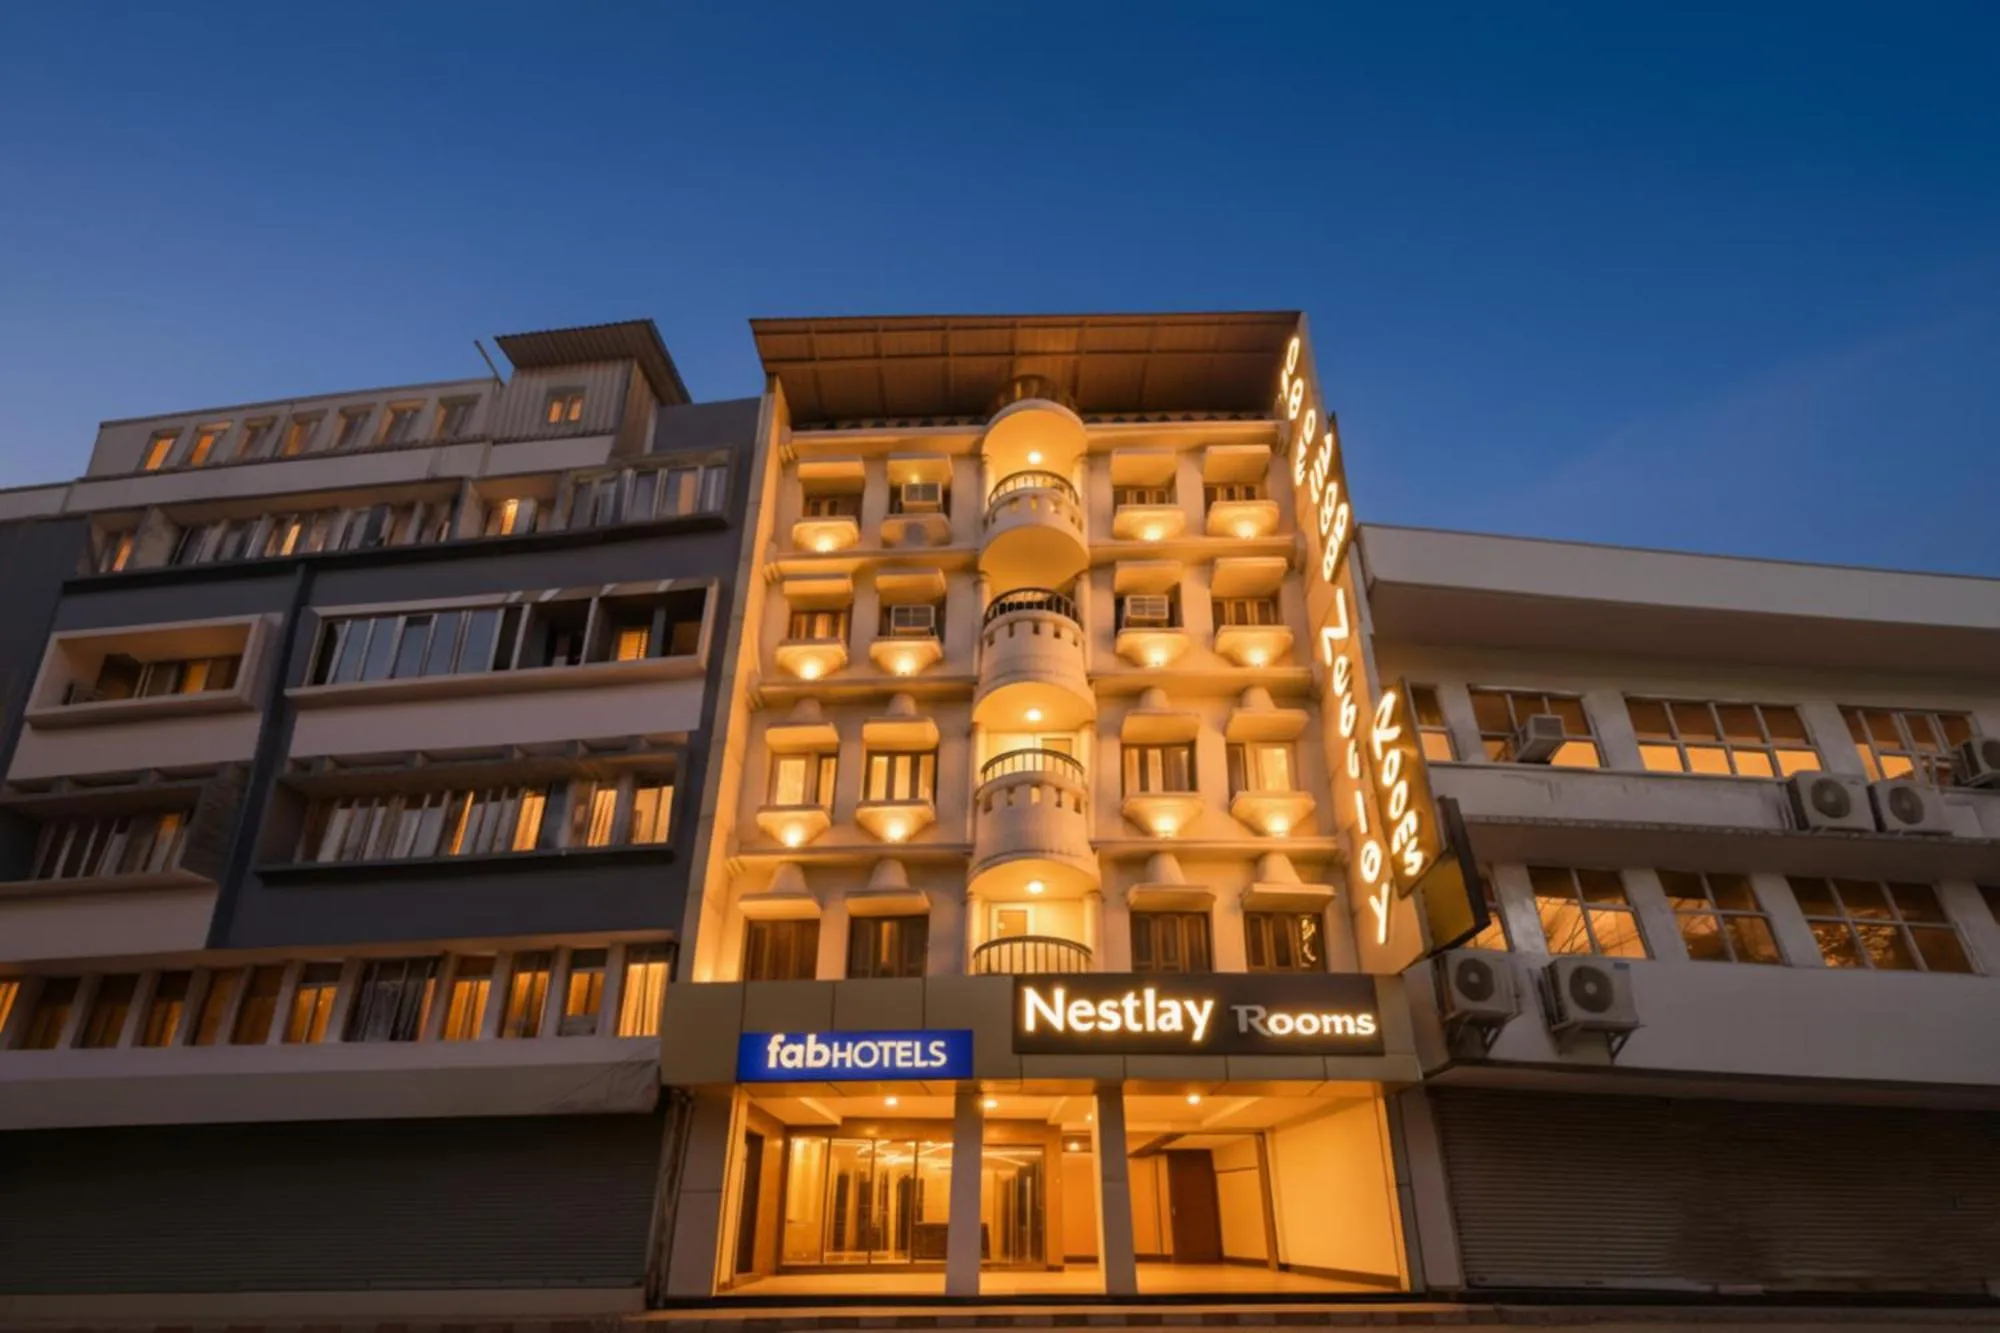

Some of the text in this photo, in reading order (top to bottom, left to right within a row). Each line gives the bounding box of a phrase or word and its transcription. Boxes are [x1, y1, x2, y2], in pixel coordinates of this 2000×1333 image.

[1023, 986, 1377, 1042] Nestlay Rooms
[767, 1033, 948, 1069] fabHOTELS
